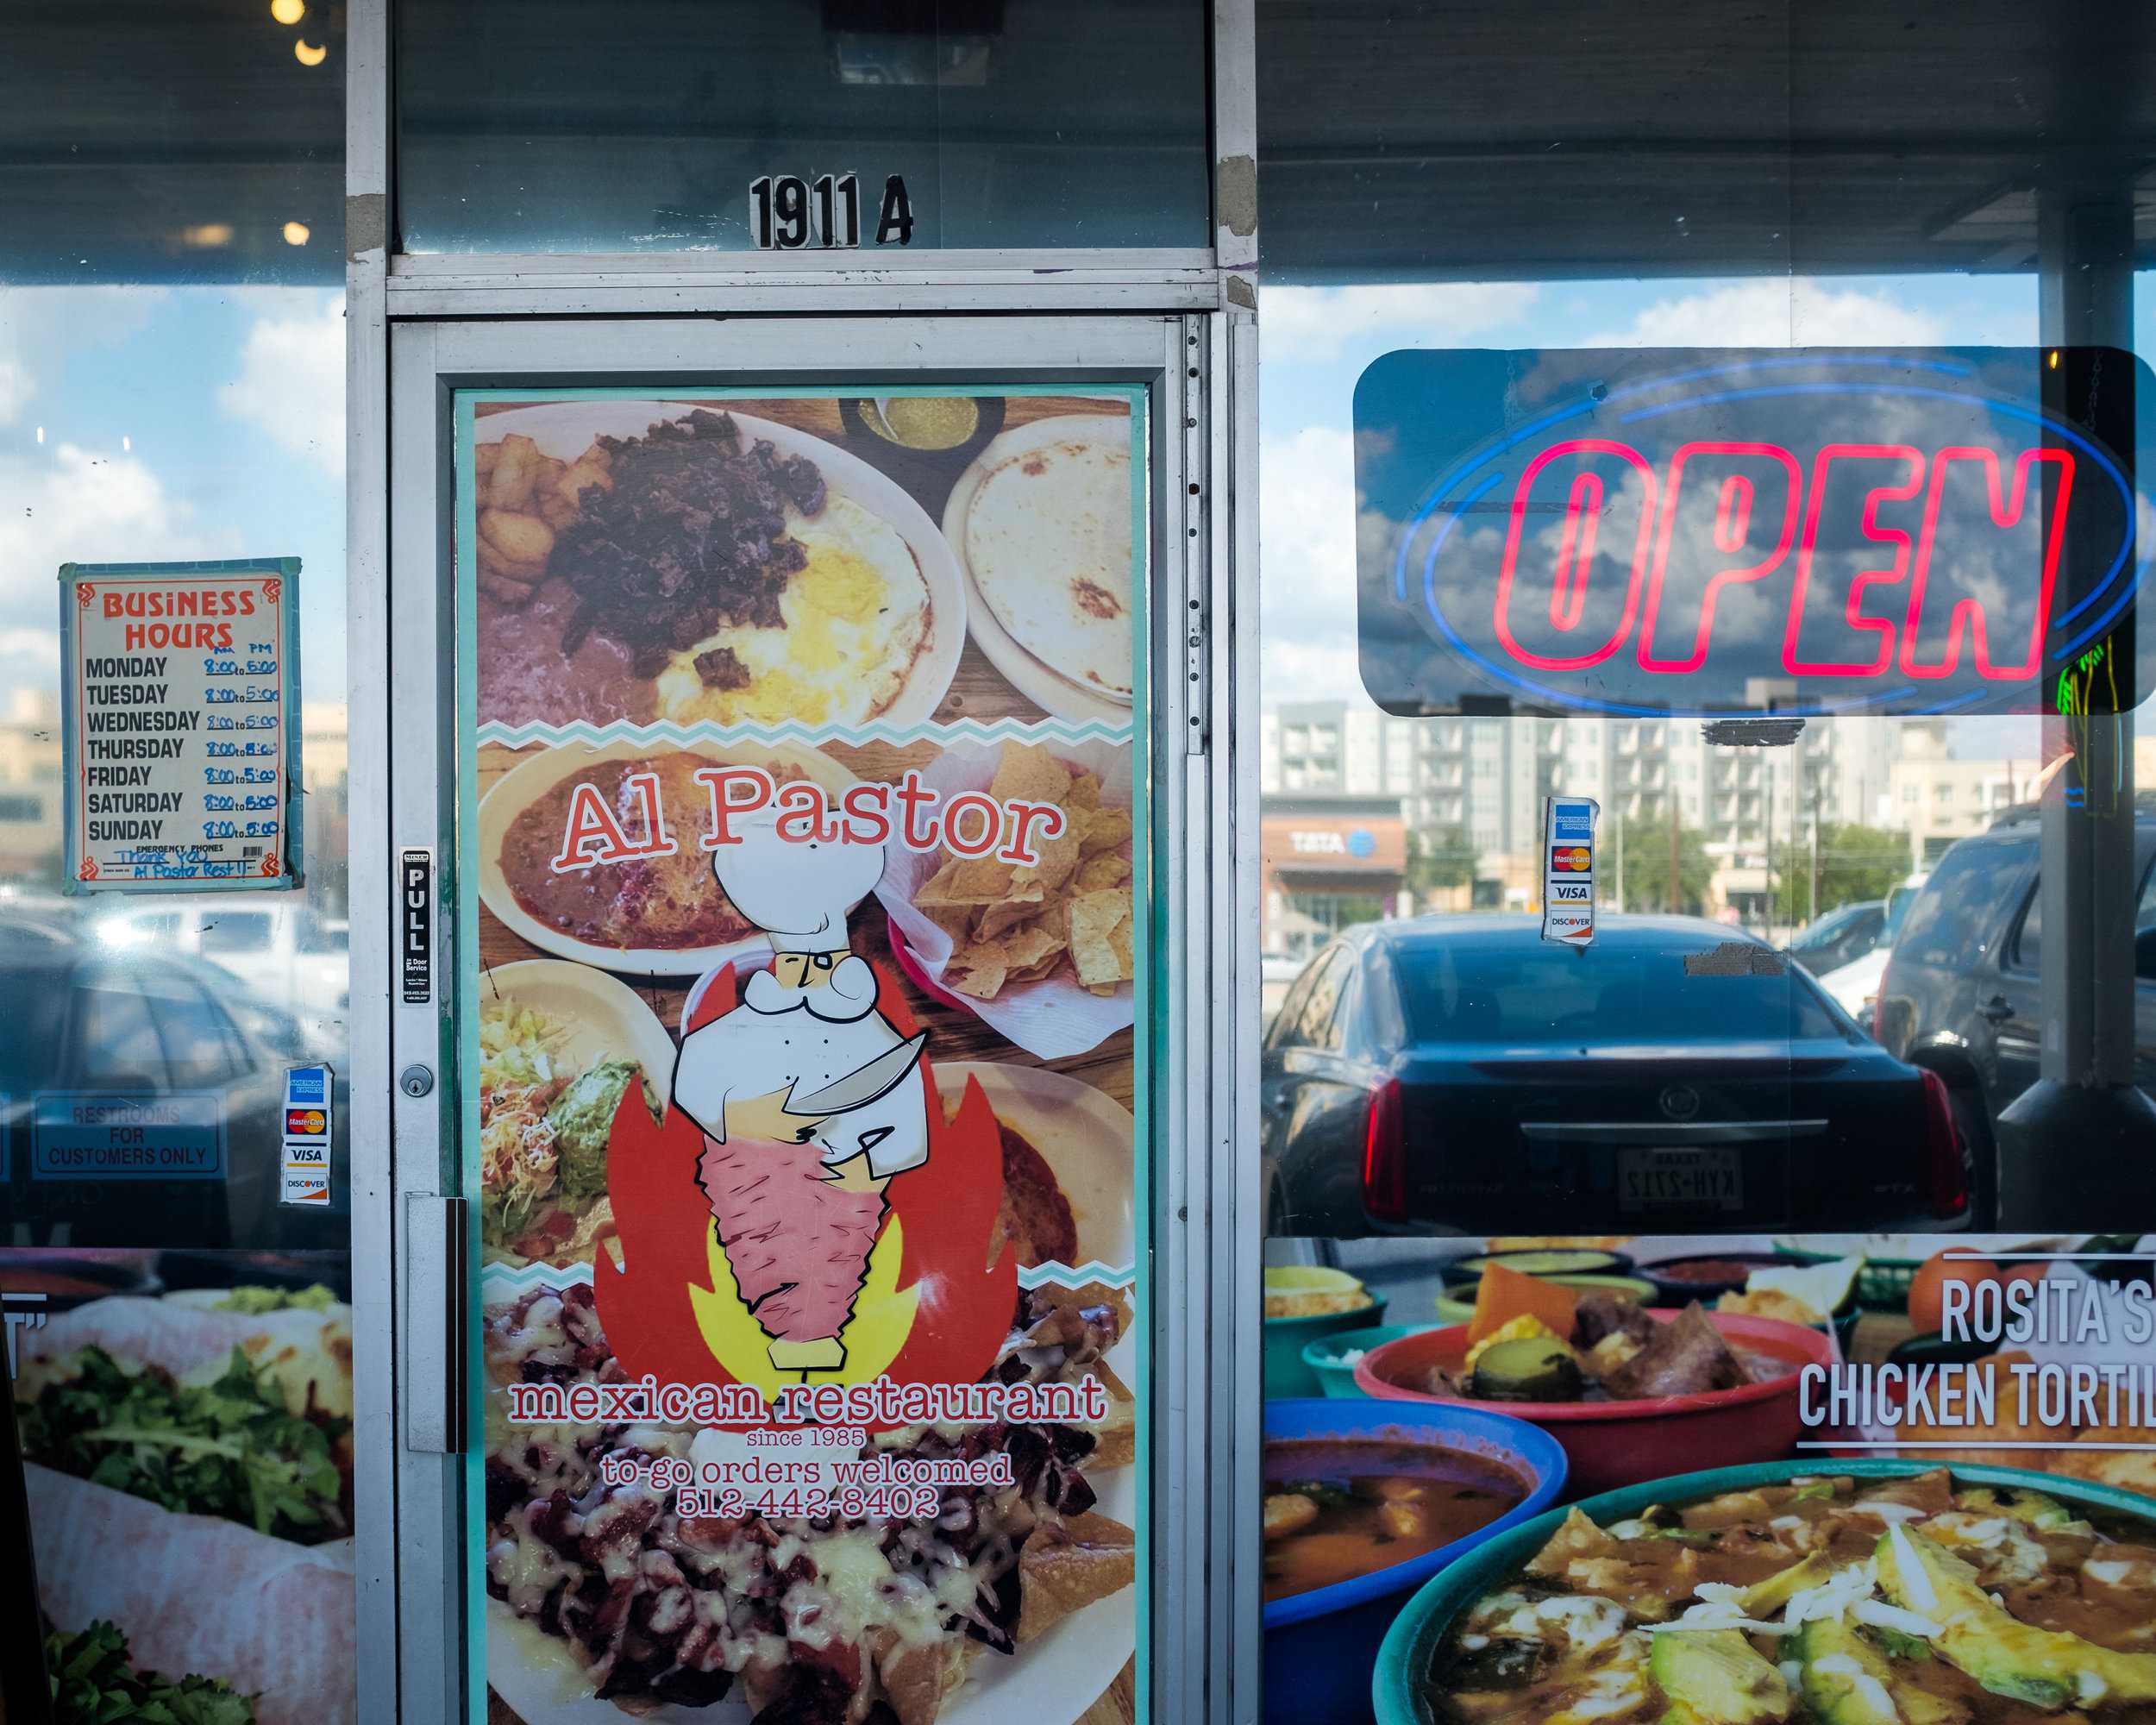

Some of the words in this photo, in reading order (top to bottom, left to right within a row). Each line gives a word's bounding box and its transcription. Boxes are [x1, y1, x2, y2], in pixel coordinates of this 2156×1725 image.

[750, 175, 860, 248] 1911
[874, 174, 914, 247] A
[1494, 438, 2074, 680] OPEN
[125, 623, 234, 652] HOURS
[248, 643, 273, 655] PM
[86, 657, 167, 678] MONDAY
[204, 659, 236, 673] 8:00
[235, 667, 245, 675] to
[86, 684, 168, 705] TUESDAY
[205, 688, 235, 702] 8:00
[235, 694, 246, 703] to
[87, 711, 200, 732] WEDNESDAY
[207, 715, 234, 728] 8:00
[87, 738, 185, 759] THURSDAY
[206, 742, 235, 755] 8:00
[88, 766, 152, 787] FRIDAY
[204, 767, 235, 782] 8:00
[88, 793, 184, 813] SATURDAY
[204, 794, 235, 808] 8:00
[554, 775, 675, 870] Al
[697, 768, 1064, 863] Pastor
[89, 820, 163, 841] SUNDAY
[203, 820, 235, 839] 8:00
[235, 830, 245, 838] to
[135, 844, 185, 854] EMERGENCY
[191, 844, 224, 853] PHONES
[1556, 888, 1588, 899] VISA
[407, 869, 425, 951] PULL
[72, 1107, 180, 1123] RESTROOMS
[289, 1118, 325, 1126] MasterCard
[110, 1127, 145, 1144] FOR
[48, 1147, 157, 1165] CUSTOMERS
[159, 1147, 206, 1164] ONLY
[291, 1150, 323, 1161] VISA
[1941, 1278, 2153, 1344] ROSITA'S
[508, 1376, 769, 1422] mexican
[780, 1376, 1108, 1422] restaurant
[1799, 1362, 1995, 1427] CHICKEN
[746, 1429, 803, 1446] since
[810, 1429, 864, 1446] 1985
[602, 1456, 693, 1490] to-go
[701, 1455, 821, 1484] orders
[833, 1455, 1012, 1484] welcomed
[676, 1487, 939, 1518] 512-442-8402
